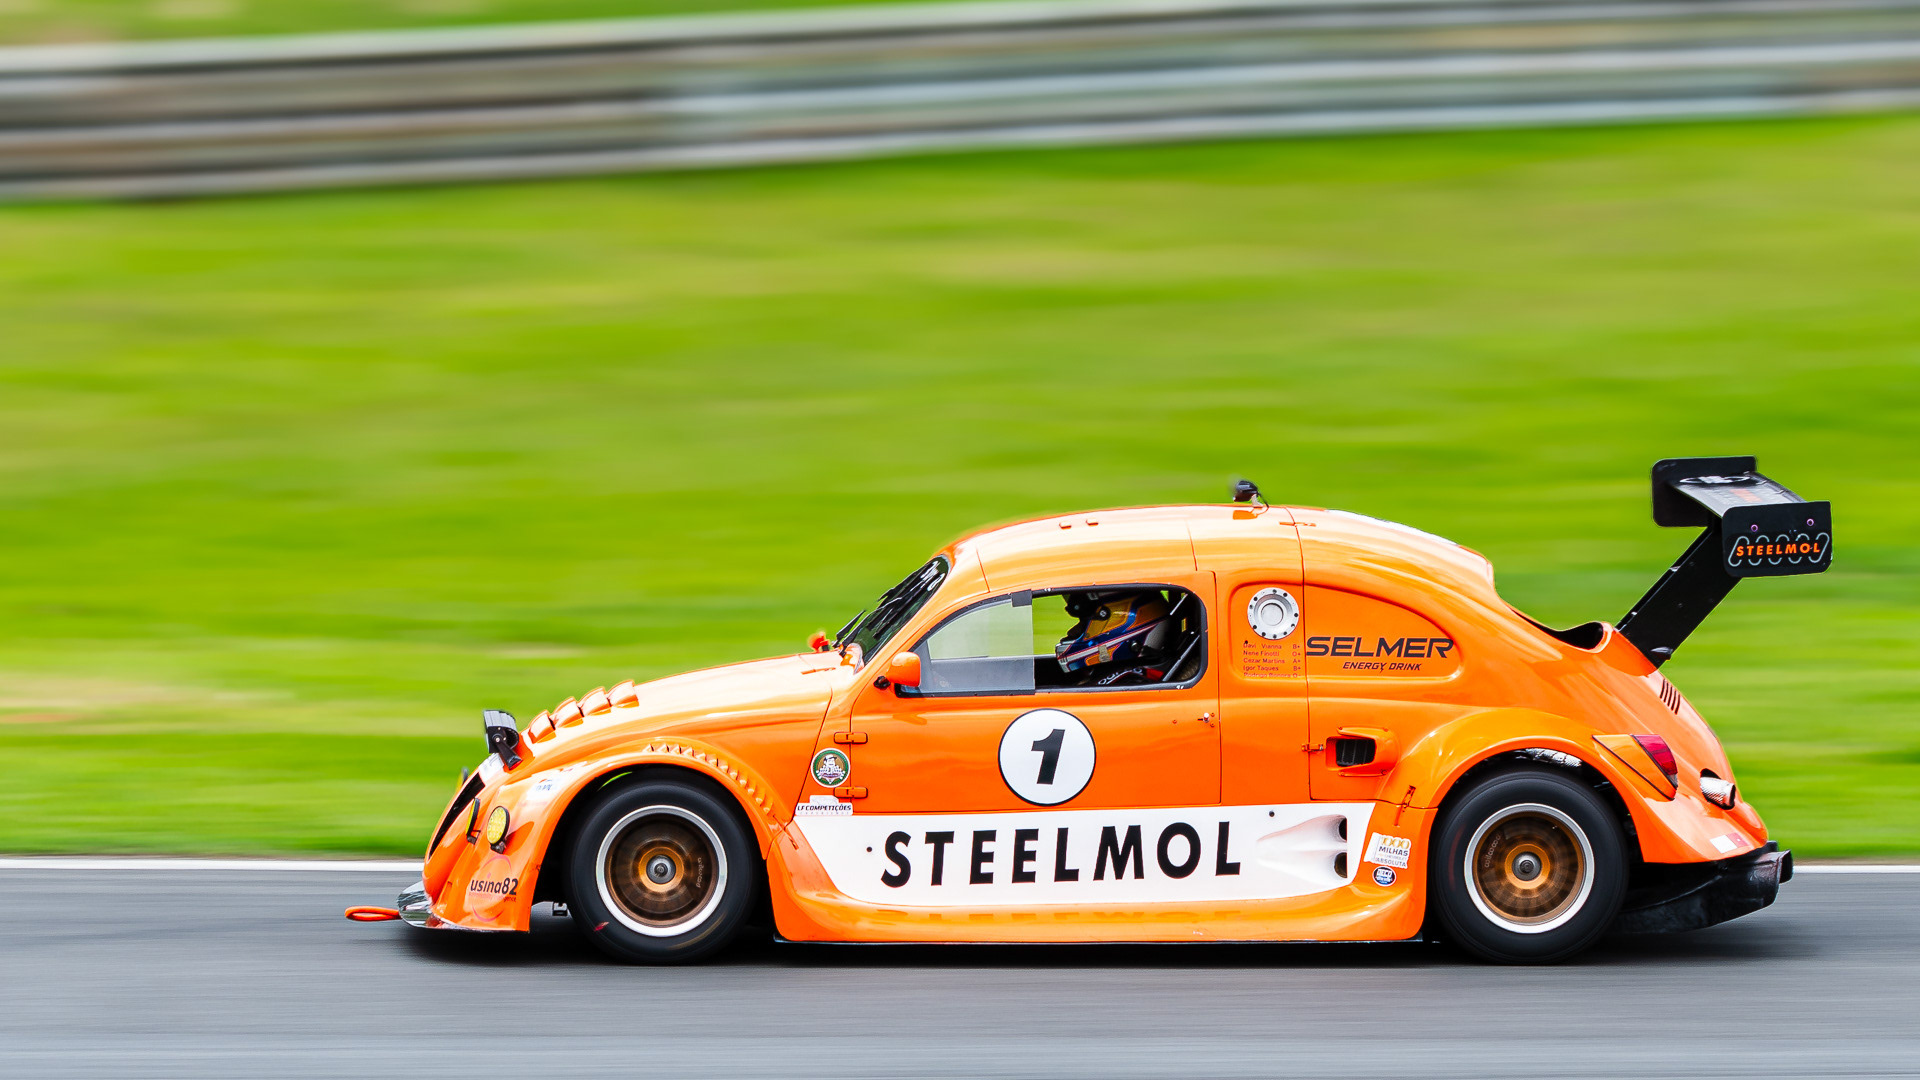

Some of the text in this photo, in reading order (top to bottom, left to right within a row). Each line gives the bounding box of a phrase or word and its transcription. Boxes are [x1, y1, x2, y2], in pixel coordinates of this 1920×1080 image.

[1736, 542, 1820, 557] STEELMOL
[1306, 636, 1454, 659] SELMER
[1343, 662, 1422, 673] ENERGY DRINK
[1030, 728, 1066, 785] 1
[880, 821, 1242, 888] STEELMOL
[1378, 845, 1409, 857] MILHAS
[470, 877, 519, 896] usina82
